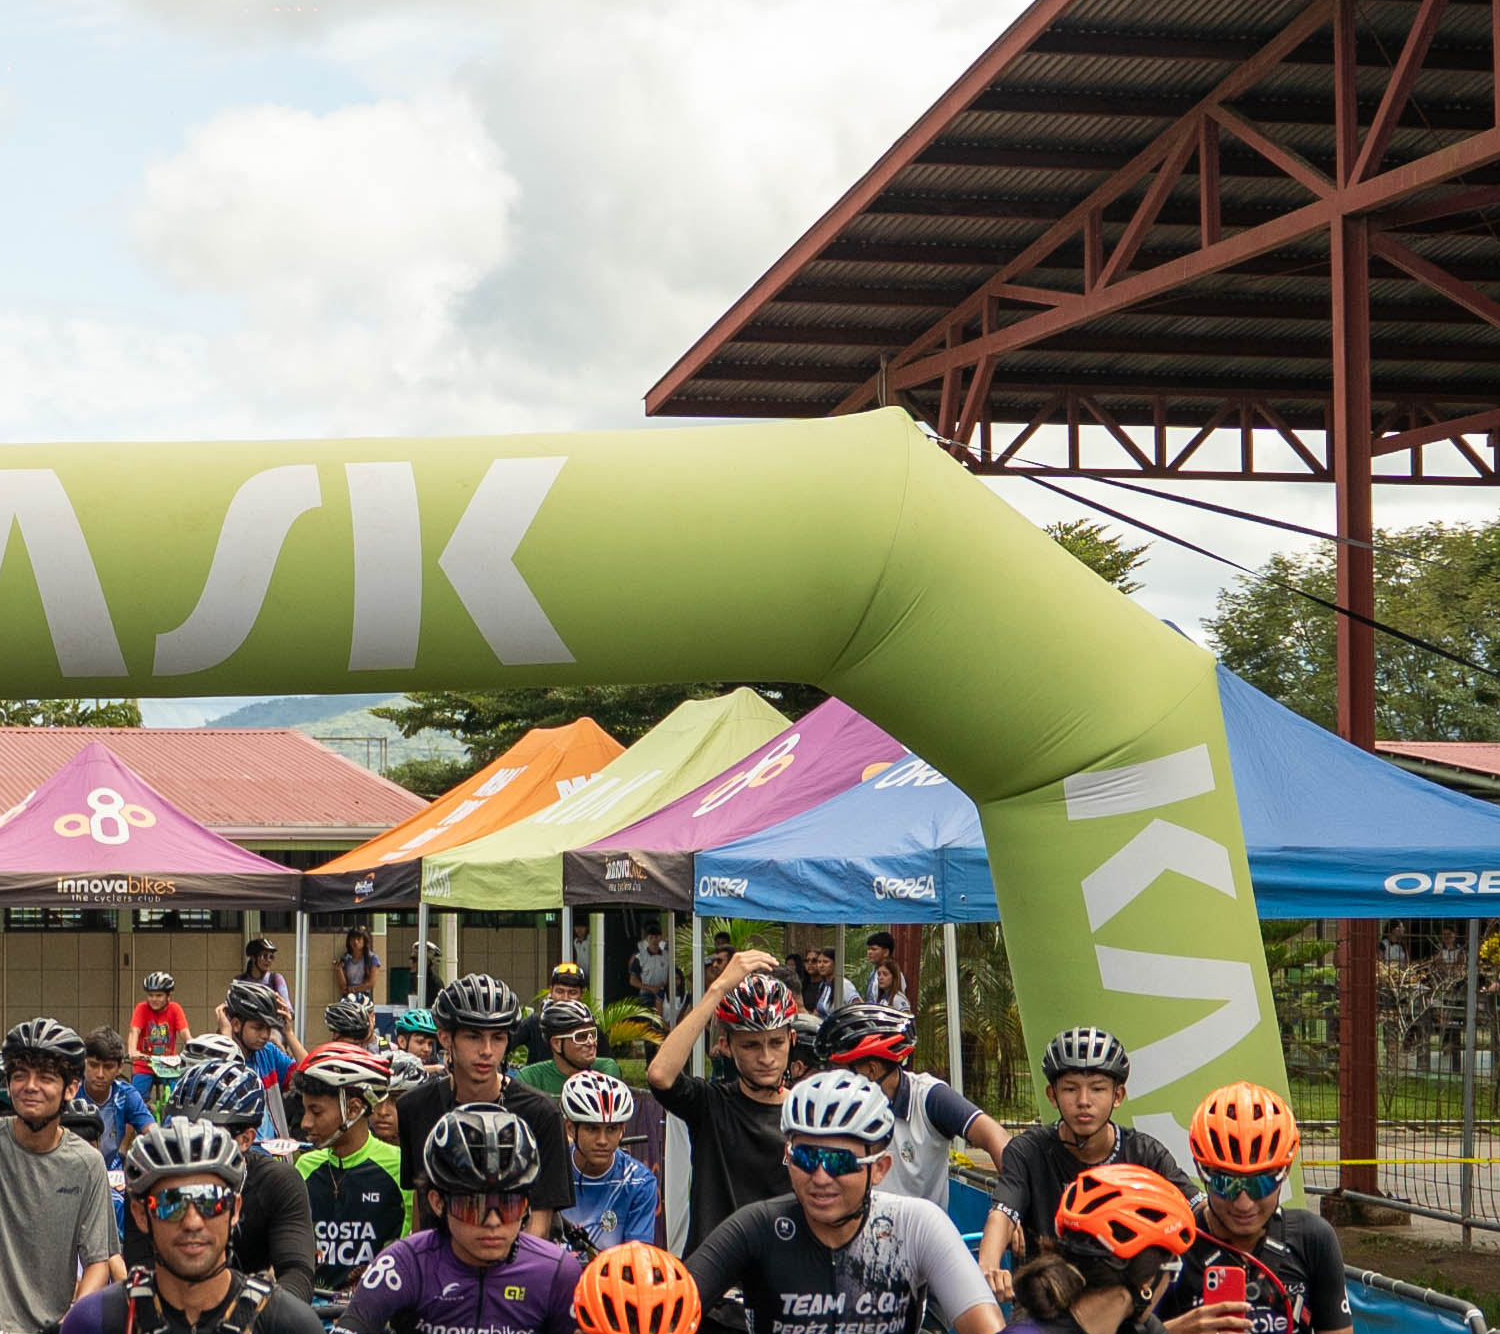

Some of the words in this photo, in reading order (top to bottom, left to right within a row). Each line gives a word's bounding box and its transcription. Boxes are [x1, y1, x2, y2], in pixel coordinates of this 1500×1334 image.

[57, 875, 176, 895] innovabikes
[699, 877, 748, 898] ORBEA
[873, 875, 936, 899] ORBEA
[71, 894, 88, 903] the
[362, 1192, 380, 1203] NG
[314, 1221, 377, 1240] COSTA
[780, 1293, 846, 1317] TEAM
